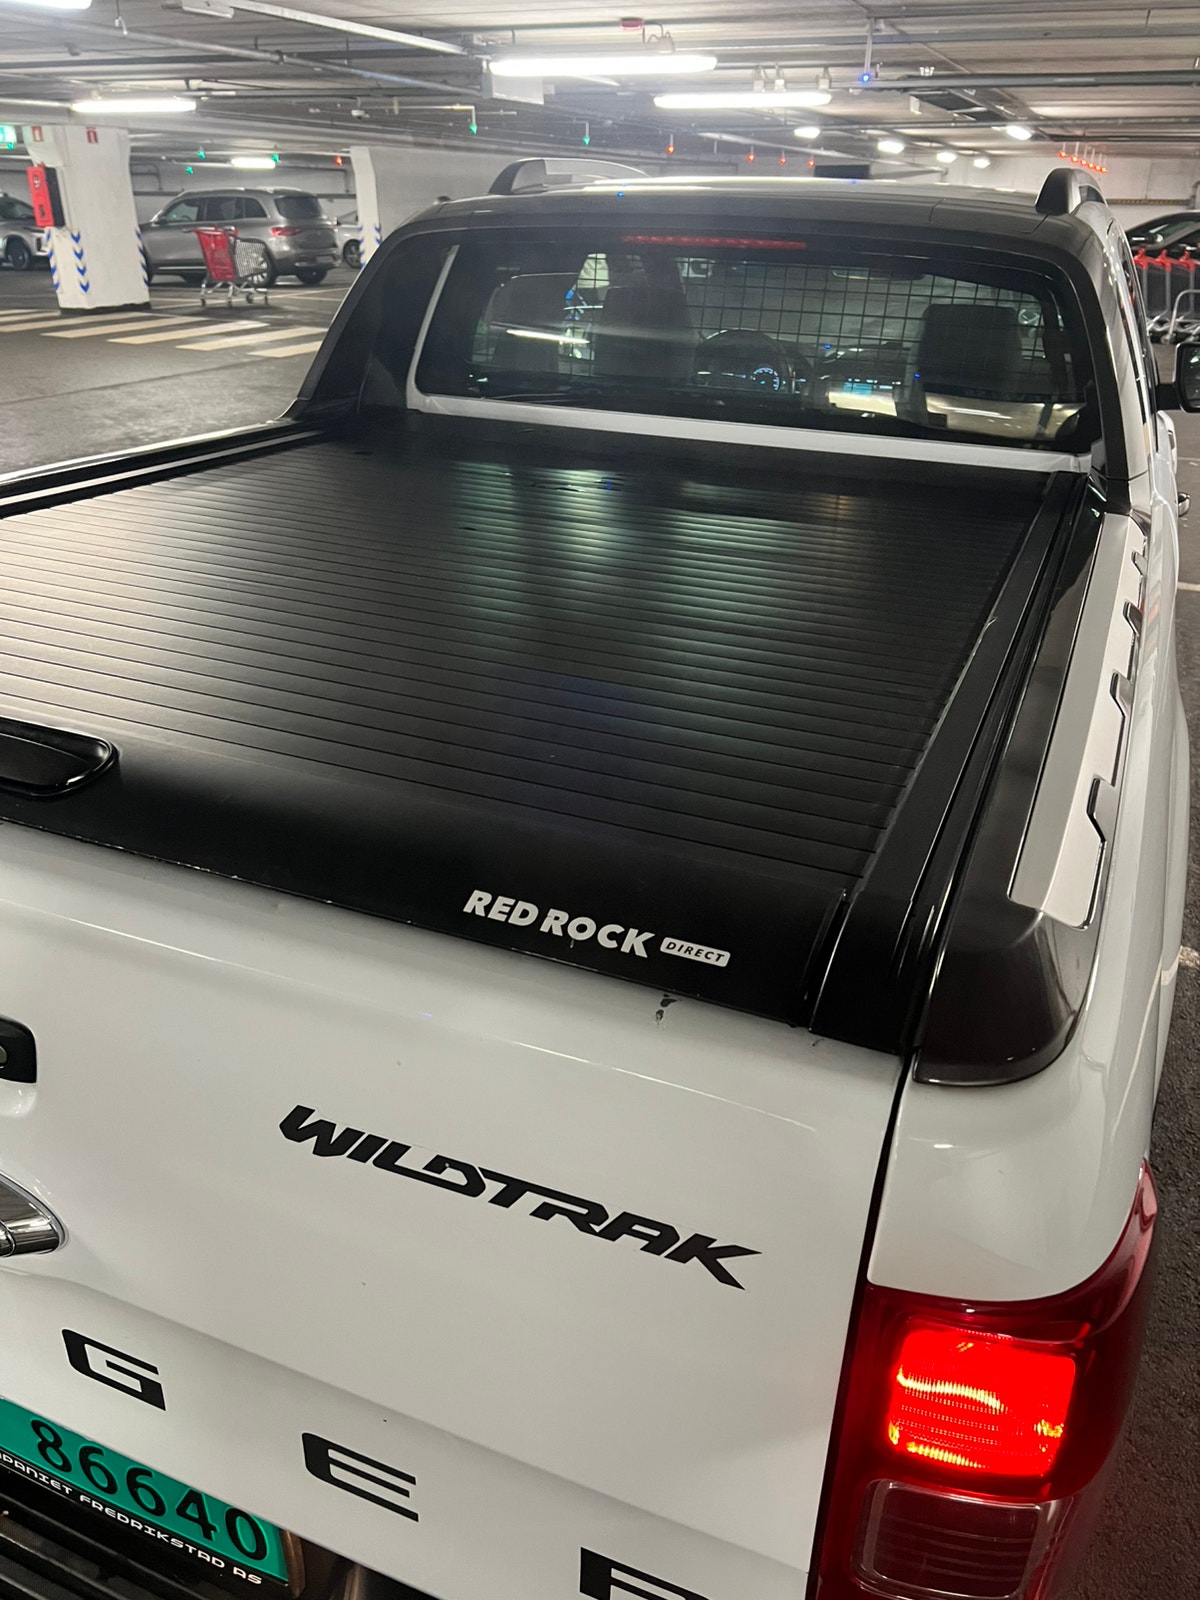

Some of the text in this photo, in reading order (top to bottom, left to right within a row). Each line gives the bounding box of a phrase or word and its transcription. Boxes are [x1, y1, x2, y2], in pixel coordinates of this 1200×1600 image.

[463, 889, 726, 964] RED ROCK DIRECT
[279, 1104, 763, 1291] WILDTRAK
[0, 1451, 263, 1586] PANIET FREDRIKSTAD AS
[30, 1418, 269, 1562] 86640
